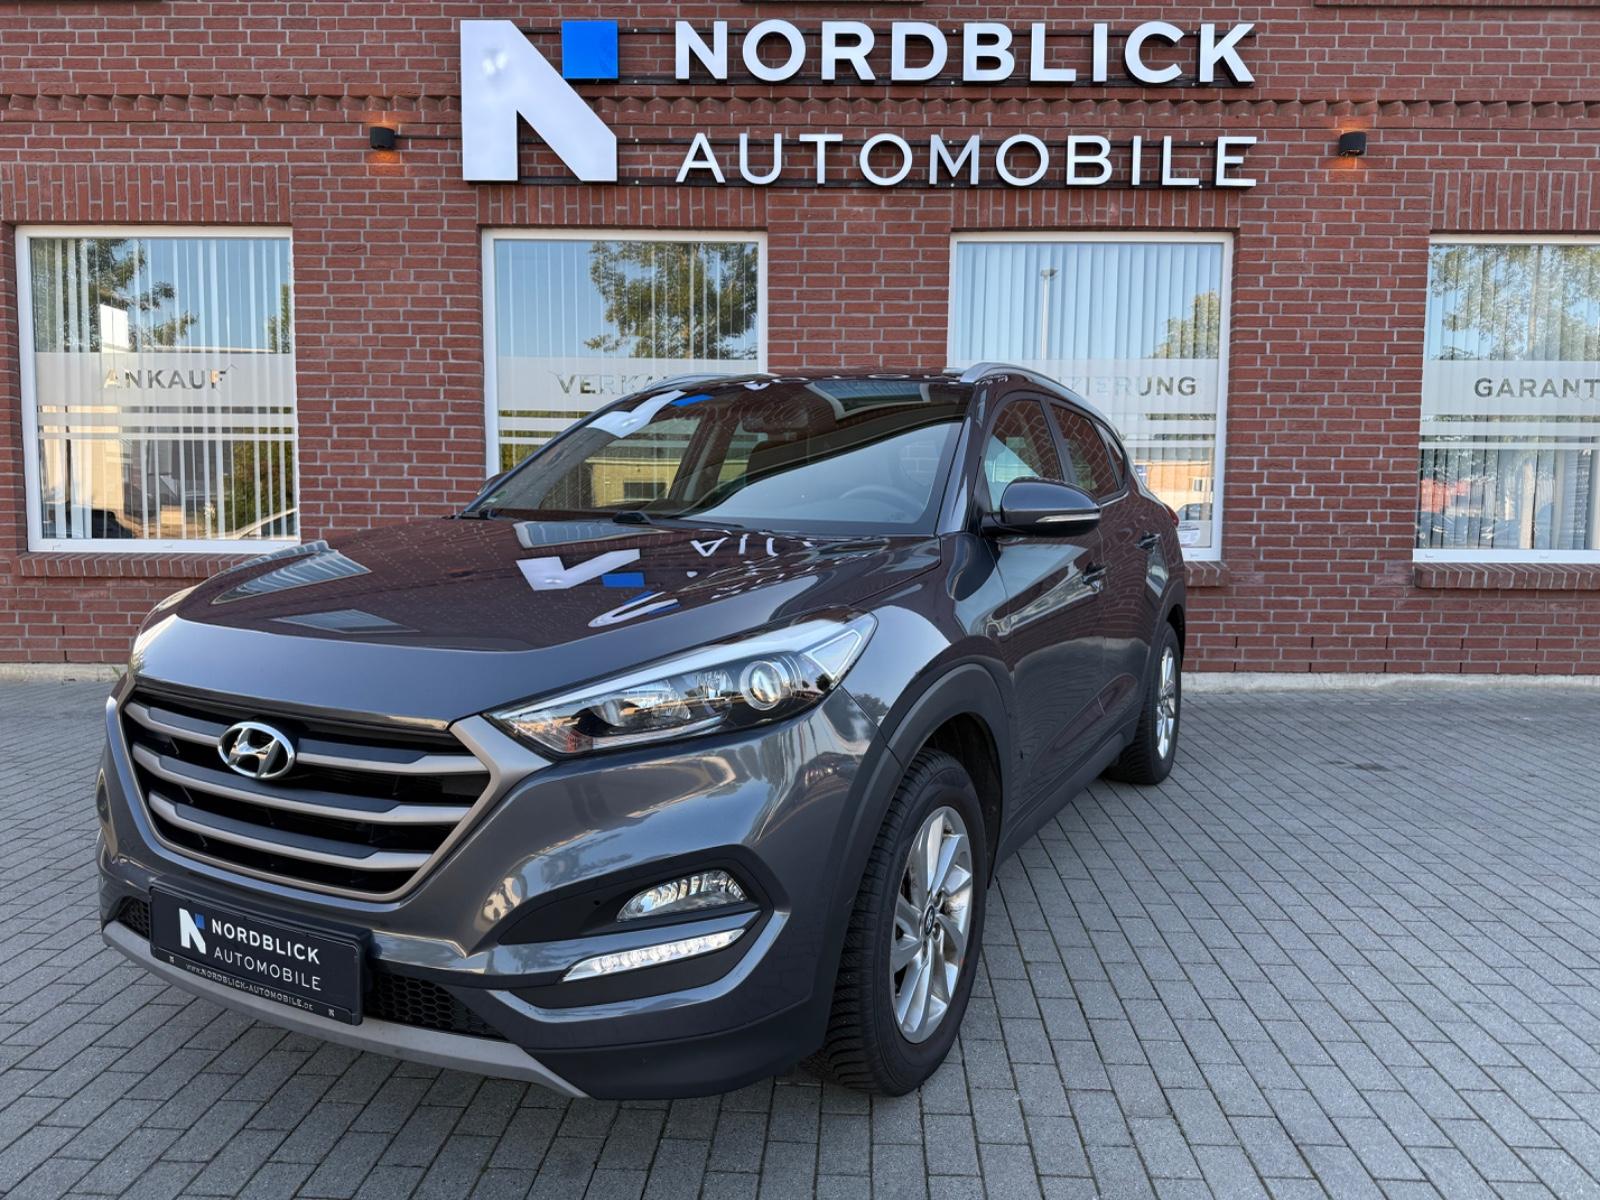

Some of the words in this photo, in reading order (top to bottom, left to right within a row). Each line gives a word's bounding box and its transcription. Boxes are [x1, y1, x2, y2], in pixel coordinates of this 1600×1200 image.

[674, 19, 1256, 84] NORDBLICK
[675, 132, 1258, 189] AUTOMOBILE
[103, 368, 226, 390] ANKAUF
[1474, 378, 1600, 399] GARANT
[211, 917, 321, 965] NORDBLICK
[213, 945, 322, 992] AUTOMOBILE
